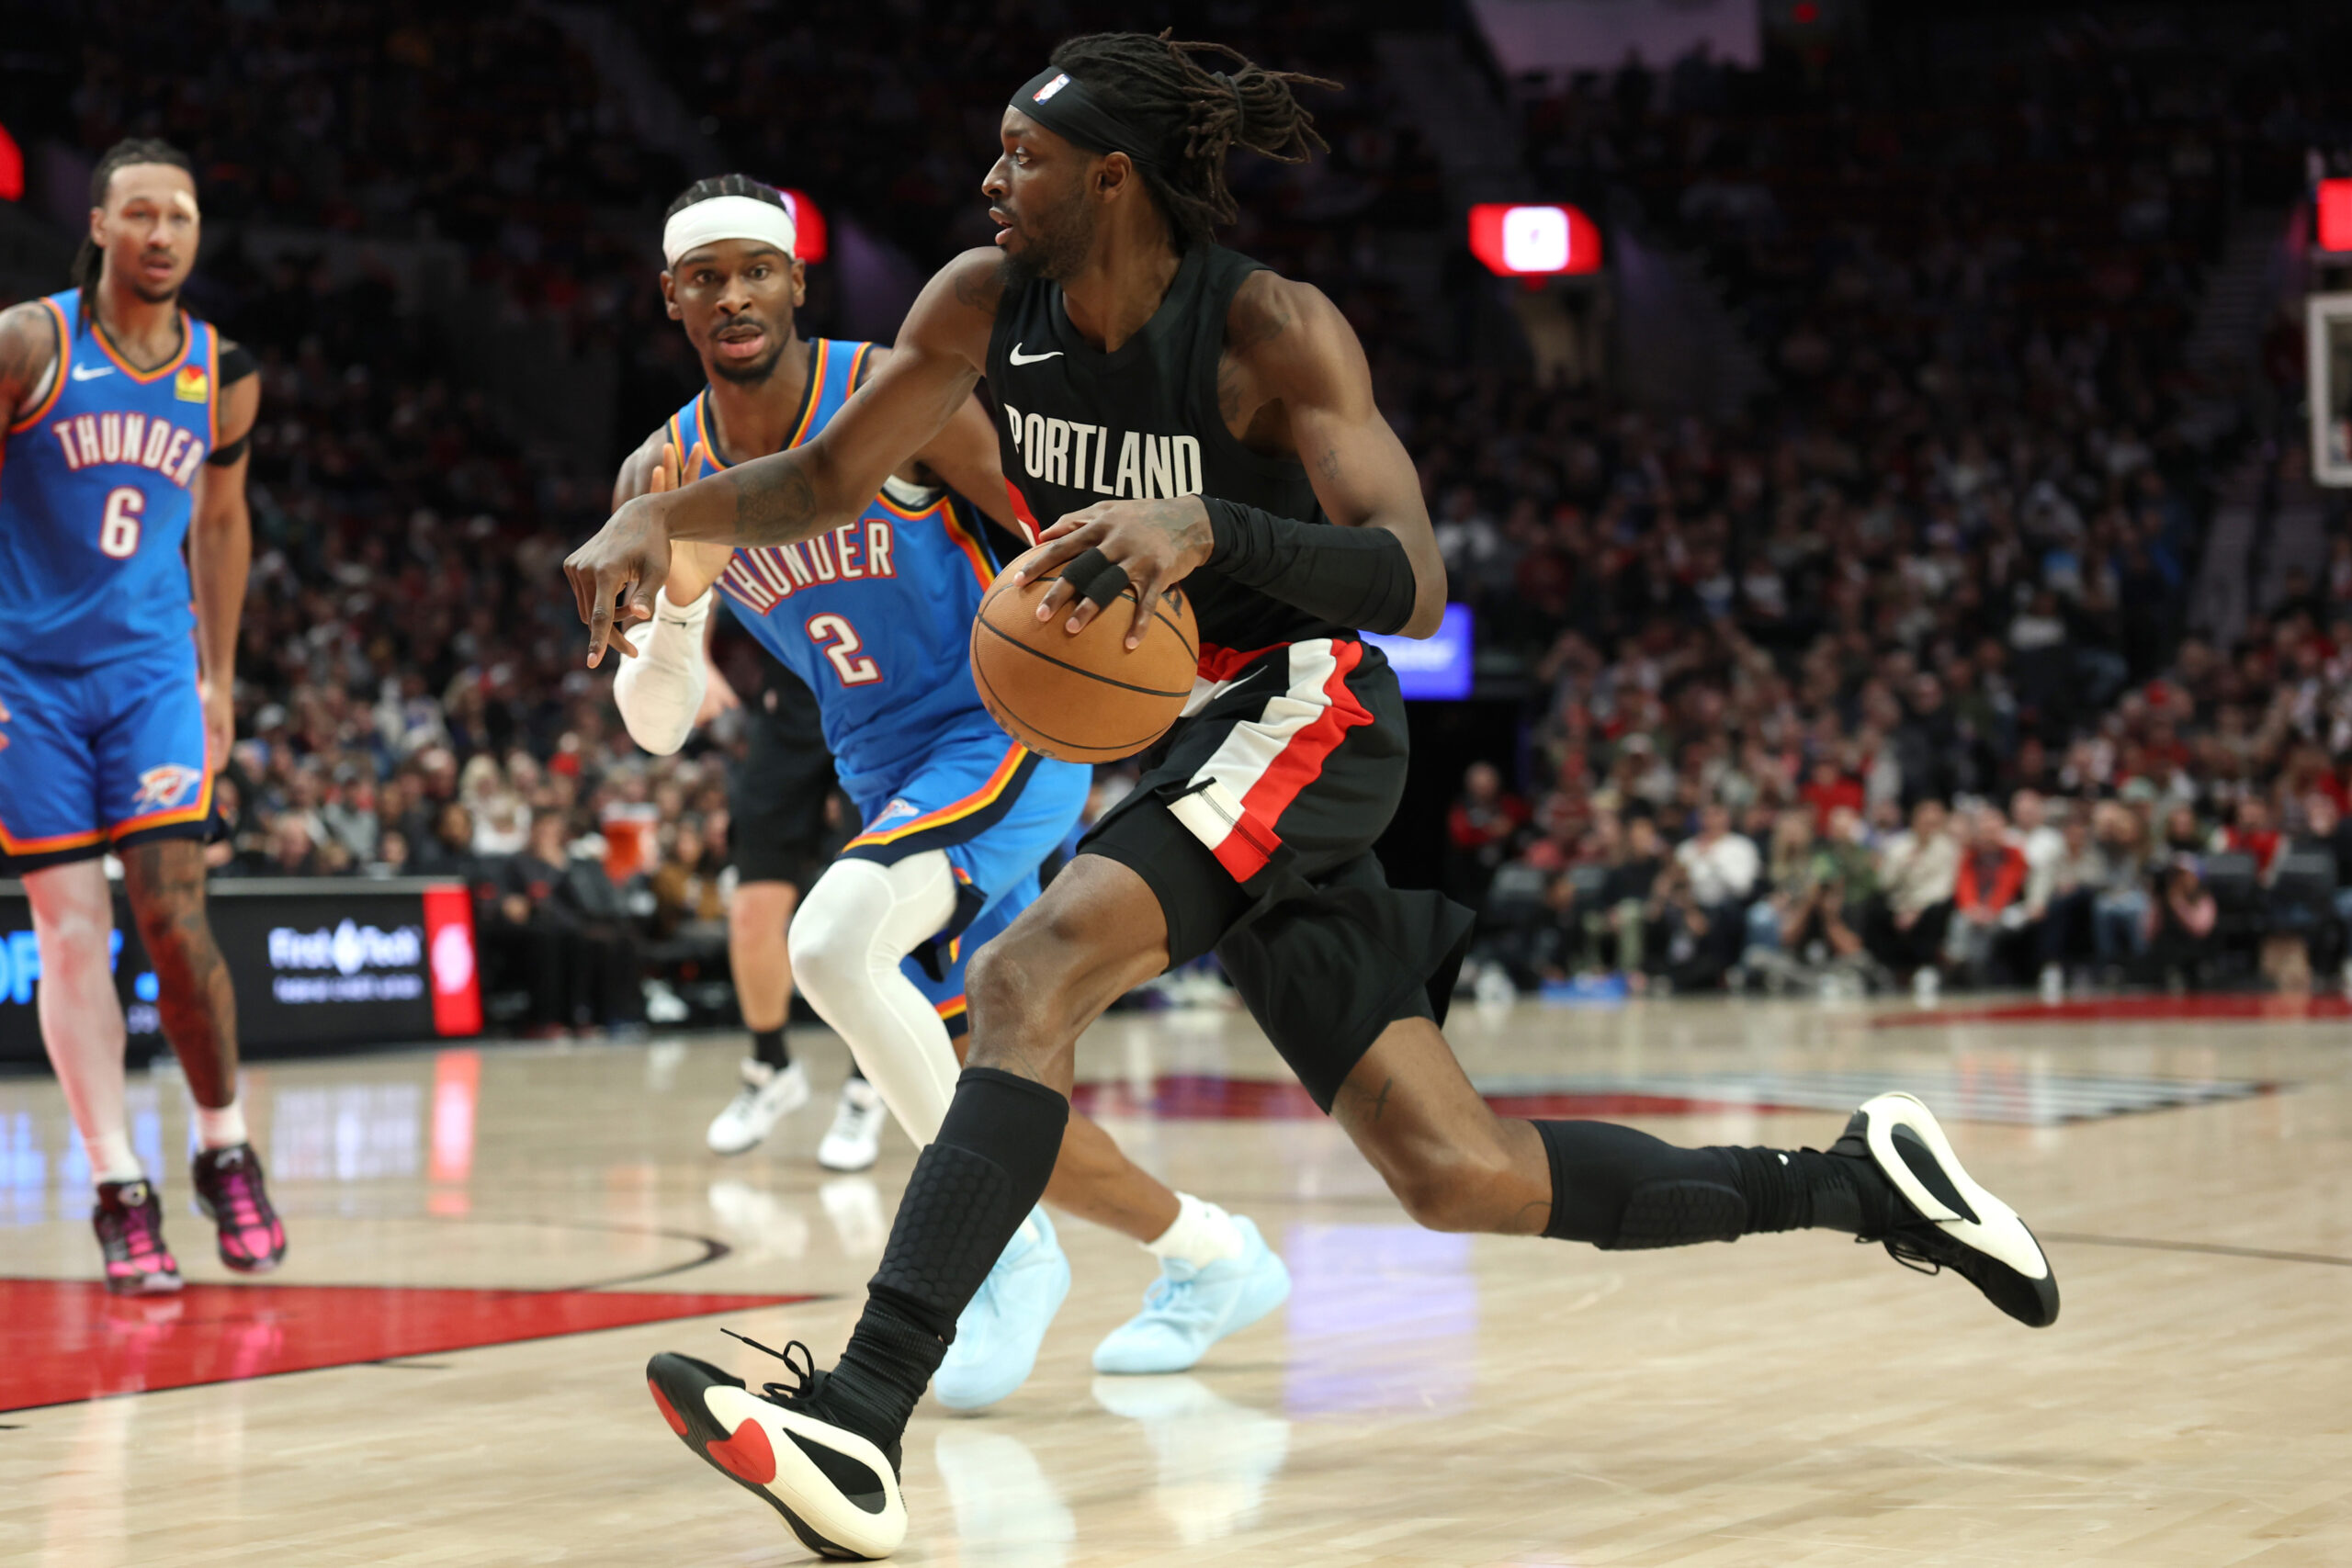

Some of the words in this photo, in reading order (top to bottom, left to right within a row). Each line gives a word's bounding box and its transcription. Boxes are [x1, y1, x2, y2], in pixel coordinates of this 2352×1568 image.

[53, 411, 205, 489] THUNDER
[1003, 402, 1204, 500] PORTLAND
[100, 485, 144, 559] 6
[805, 613, 884, 687] 2
